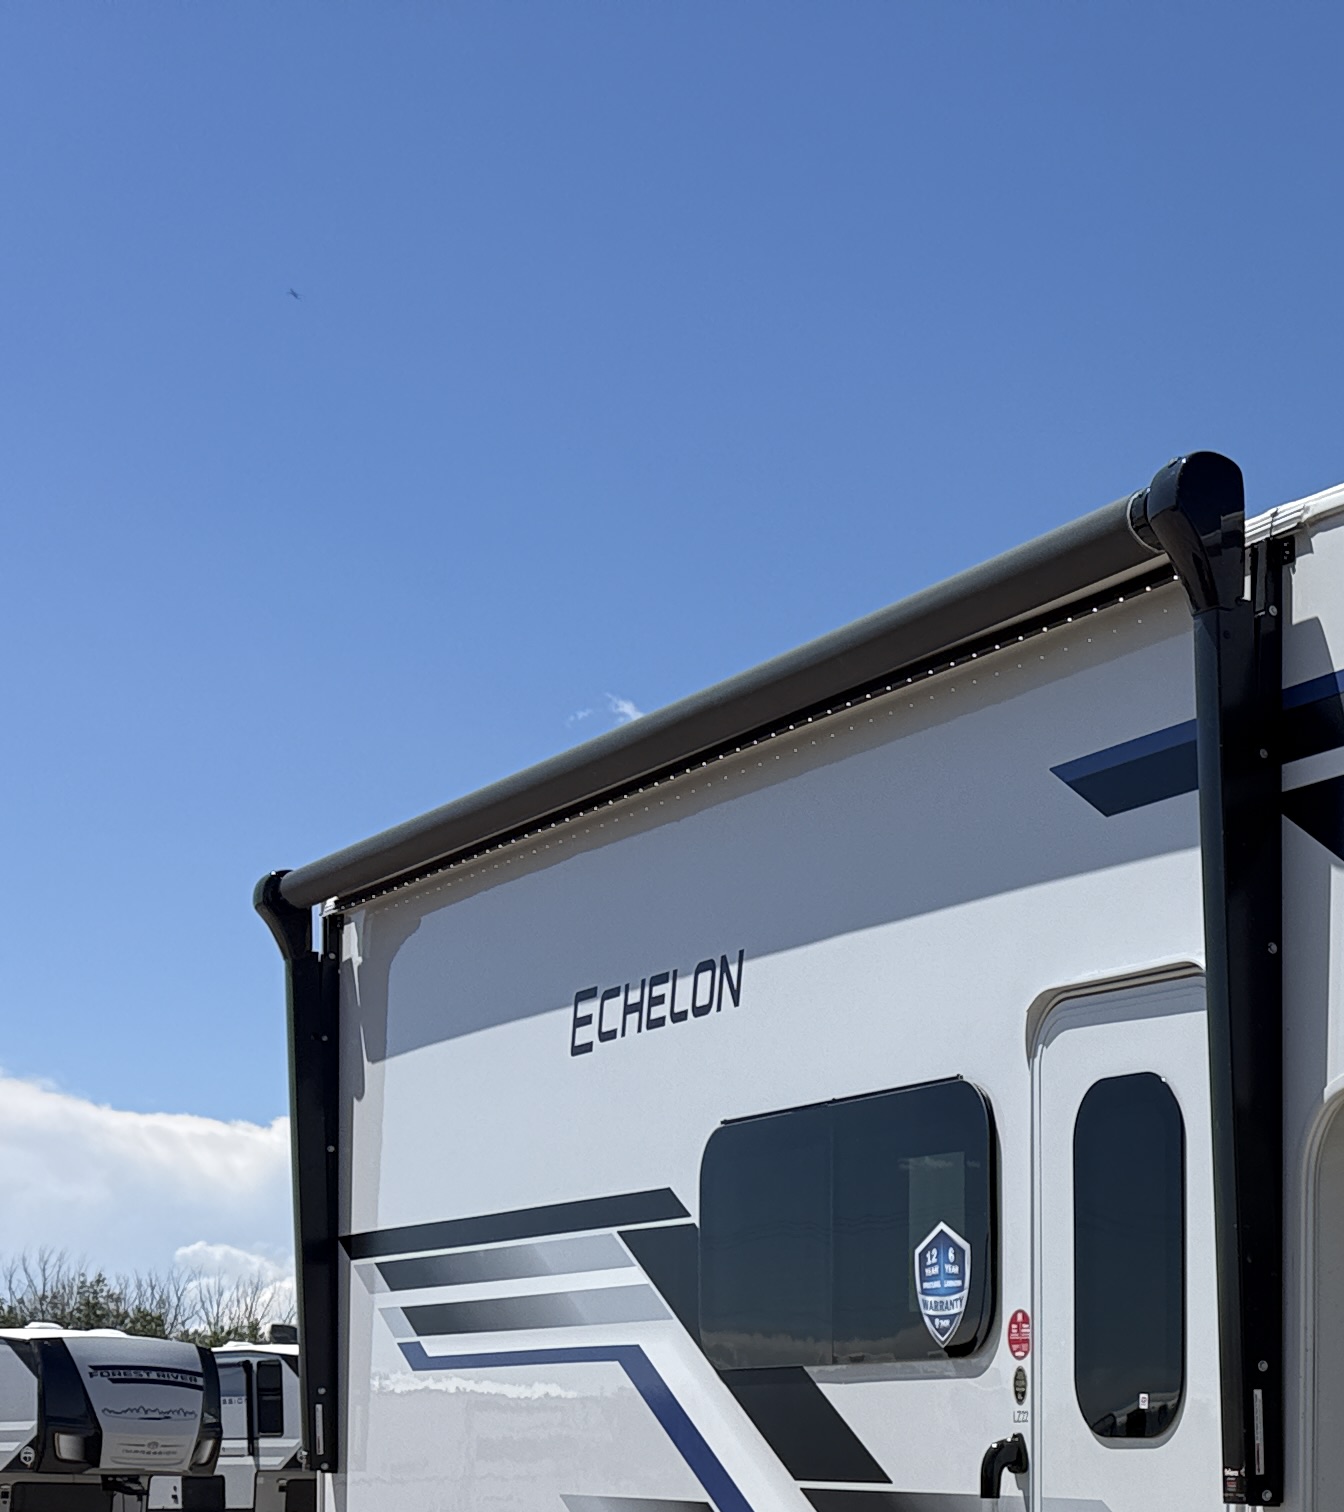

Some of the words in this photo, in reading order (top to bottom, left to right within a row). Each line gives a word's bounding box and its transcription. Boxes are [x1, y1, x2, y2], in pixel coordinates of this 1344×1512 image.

[570, 949, 745, 1057] ECHELON
[925, 1247, 938, 1266] 12
[948, 1246, 955, 1263] 6
[921, 1296, 965, 1312] WARRANTY
[88, 1370, 151, 1379] FOREST
[156, 1371, 198, 1383] RIVER
